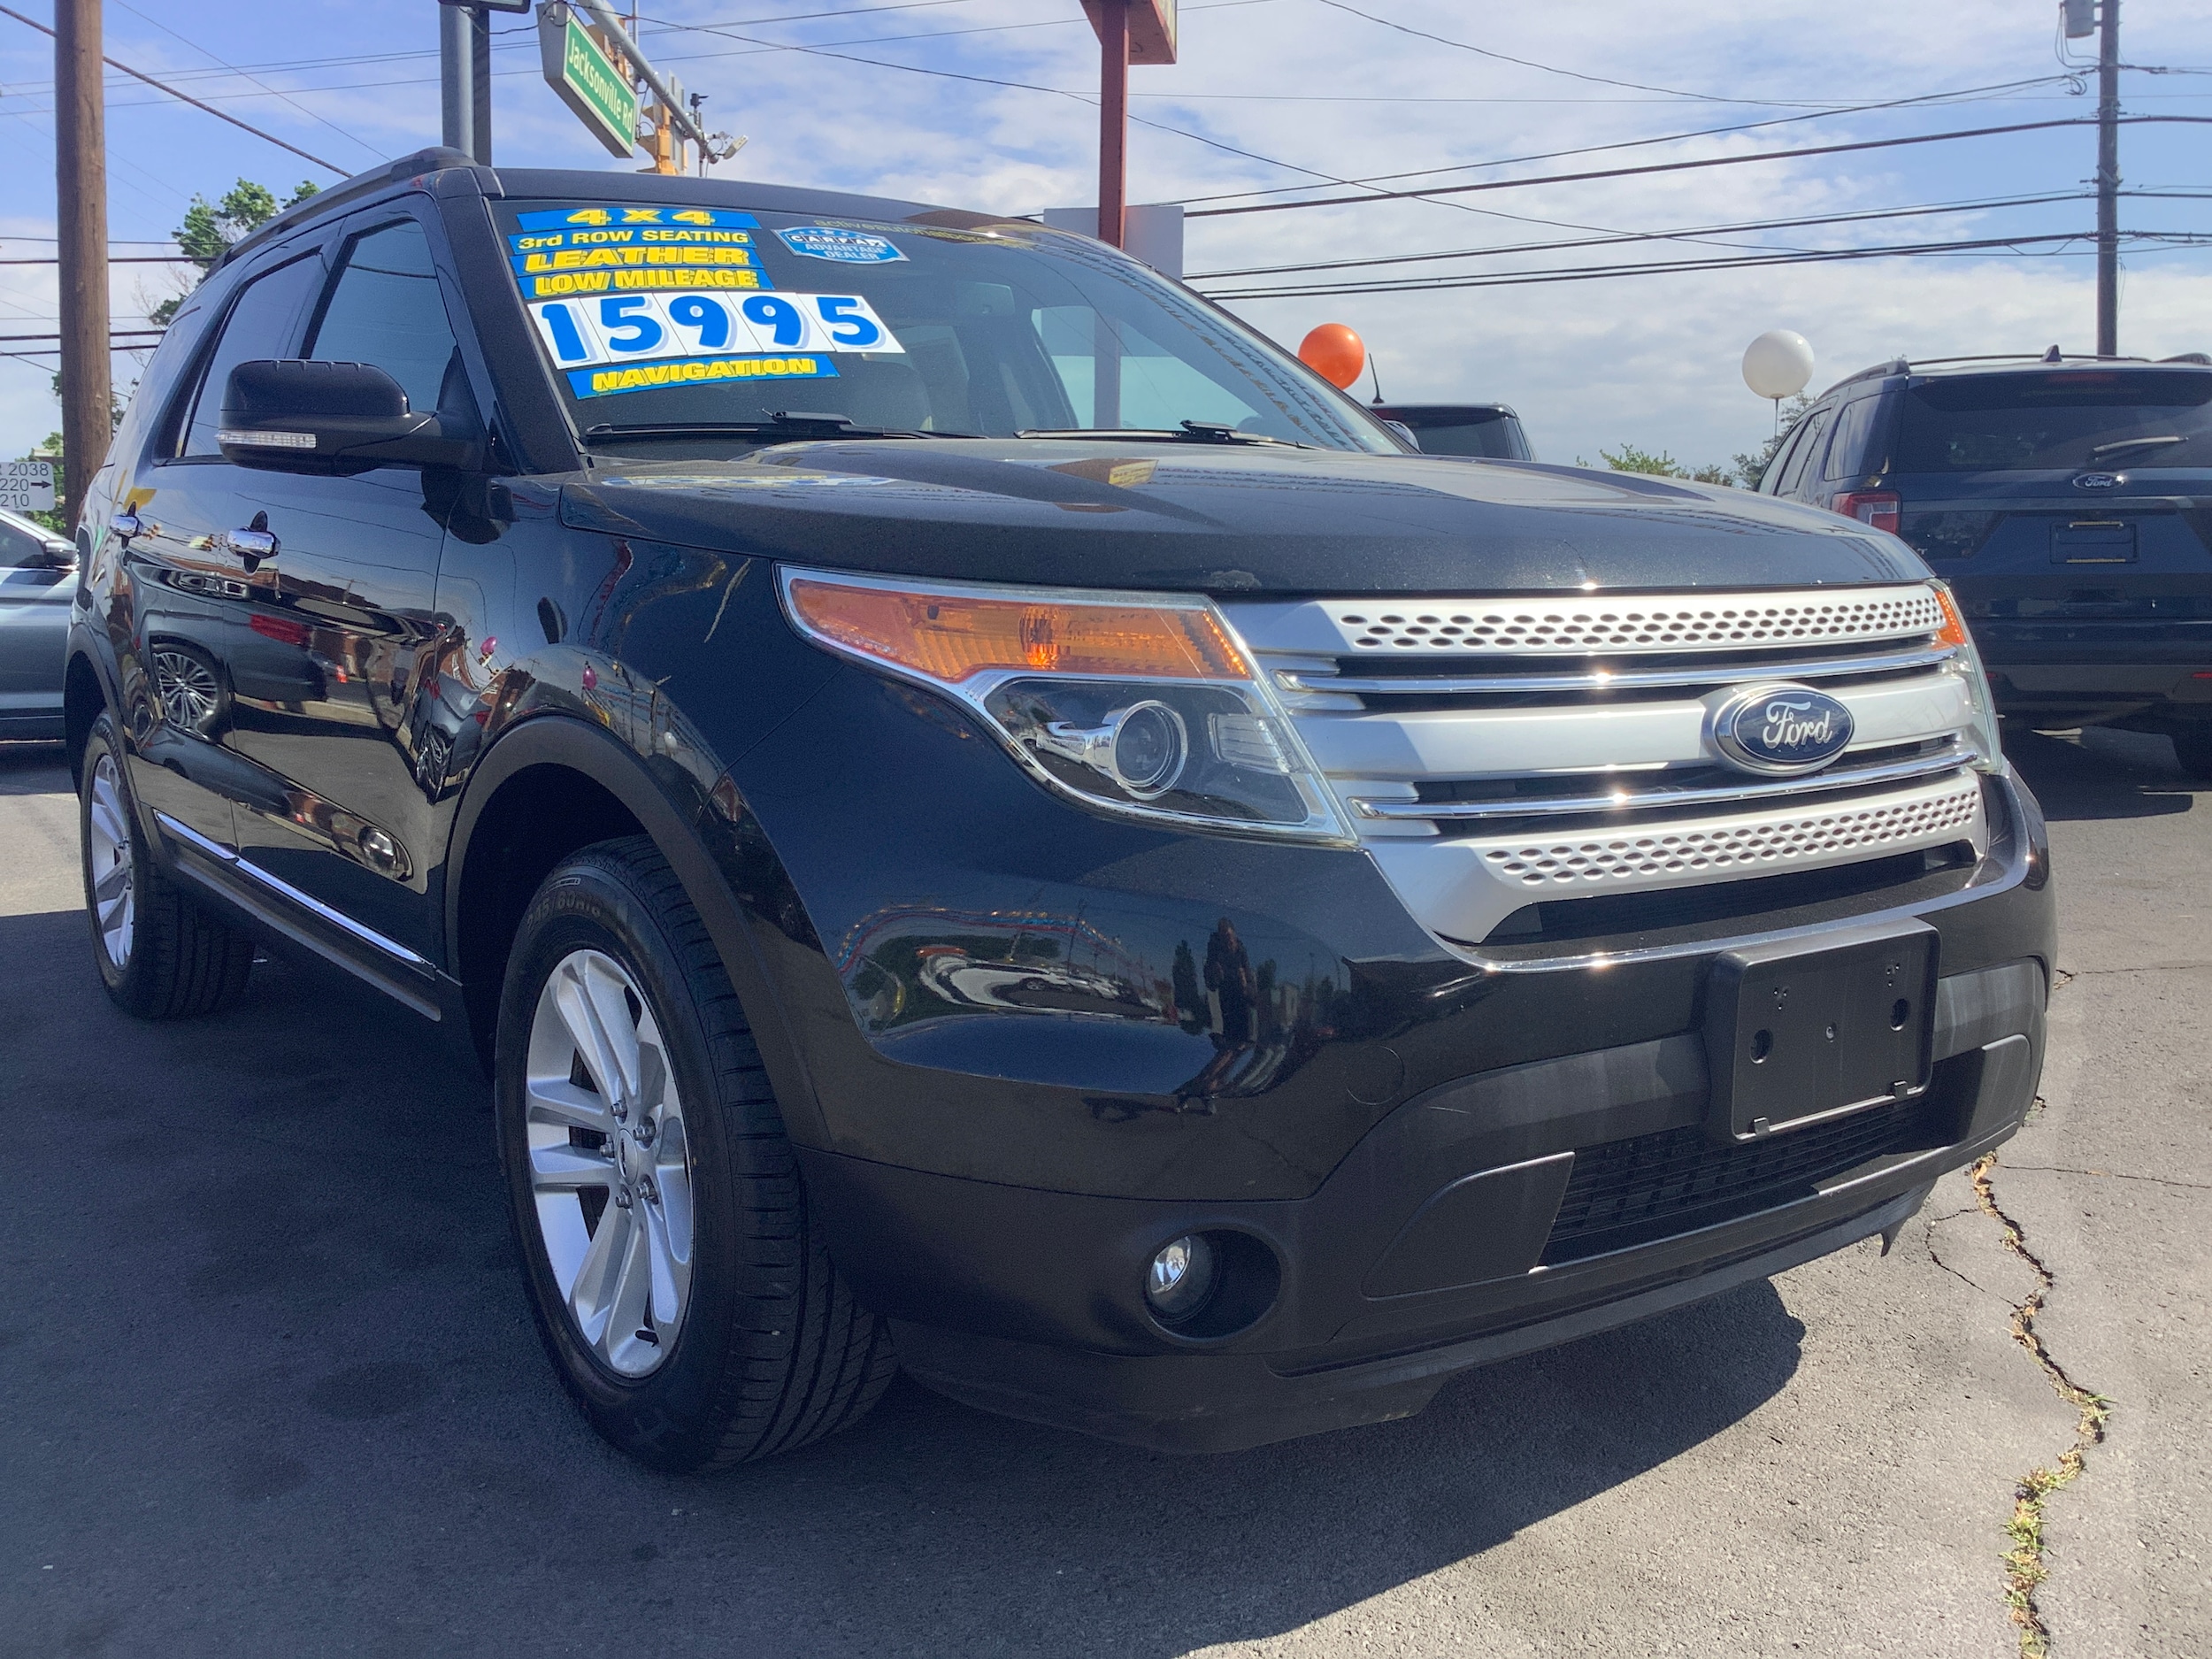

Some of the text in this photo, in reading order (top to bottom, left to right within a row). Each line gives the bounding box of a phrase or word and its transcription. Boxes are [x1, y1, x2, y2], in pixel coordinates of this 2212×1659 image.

[568, 37, 634, 134] Jacksonville Rd
[566, 208, 612, 226] 4
[672, 210, 716, 226] 4
[518, 230, 749, 250] 3rd ROW SEATING
[790, 234, 887, 248] CARFAX
[805, 243, 888, 255] ADVANTAGE
[526, 247, 750, 273] LEATHER
[825, 250, 880, 260] DEALER
[535, 268, 759, 296] LOW MILEAGE
[541, 295, 885, 365] 15995
[592, 357, 817, 392] NAVIGATION
[8, 463, 49, 477] 2038
[0, 478, 29, 491] 220
[2085, 475, 2113, 487] Ford
[0, 494, 30, 507] 210
[1763, 701, 1833, 749] Ford
